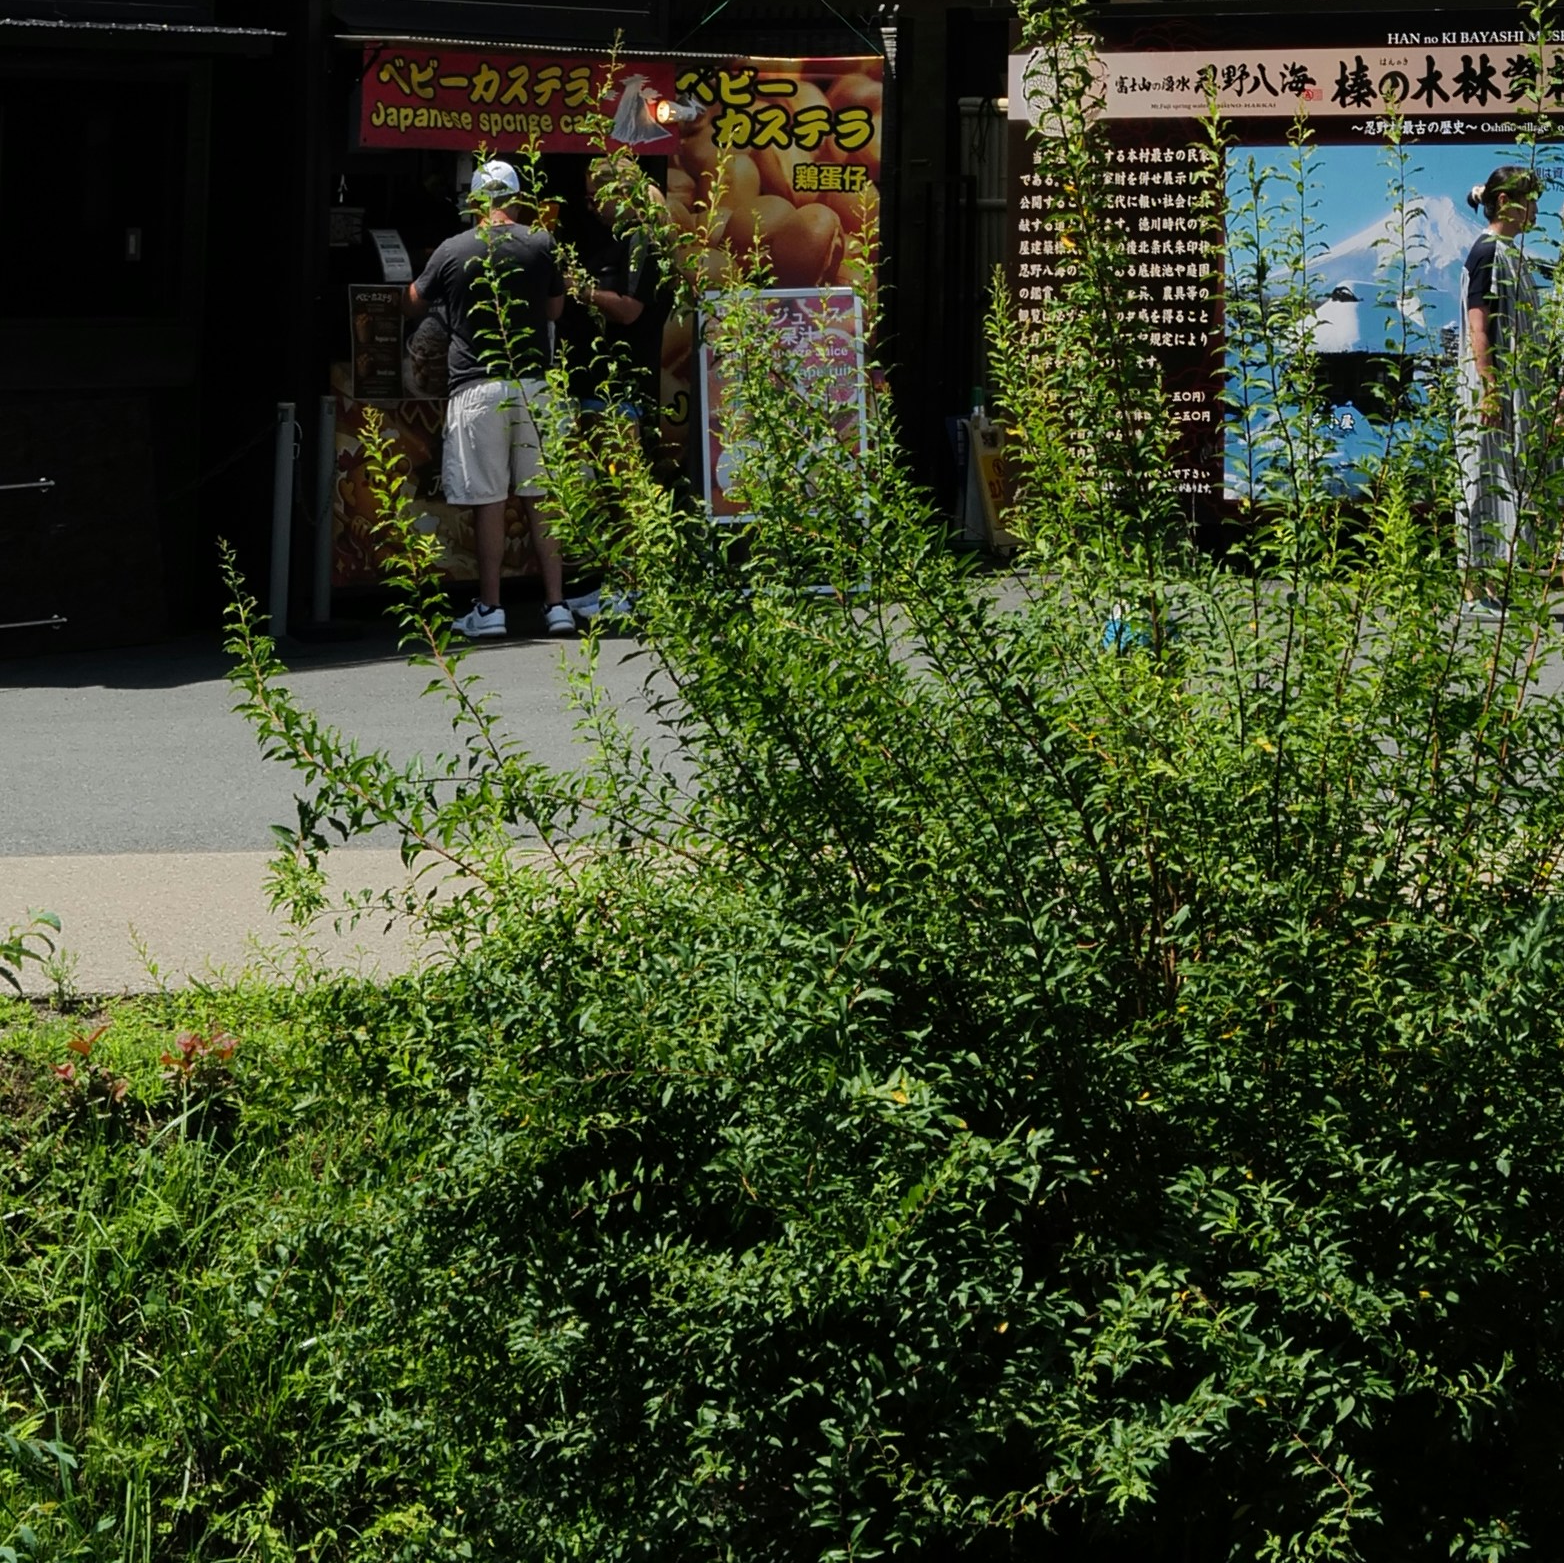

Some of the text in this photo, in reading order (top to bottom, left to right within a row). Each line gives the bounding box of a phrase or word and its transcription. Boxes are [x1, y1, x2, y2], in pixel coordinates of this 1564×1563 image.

[1387, 32, 1422, 45] HAN
[1424, 35, 1439, 45] no
[1441, 32, 1457, 44] KI
[1460, 31, 1525, 44] BAYASHI
[378, 58, 591, 107] ベビーカステラ
[1194, 61, 1317, 98] 忍野八海
[371, 101, 615, 137] Japanese sponge ca
[714, 108, 872, 149] カステラ
